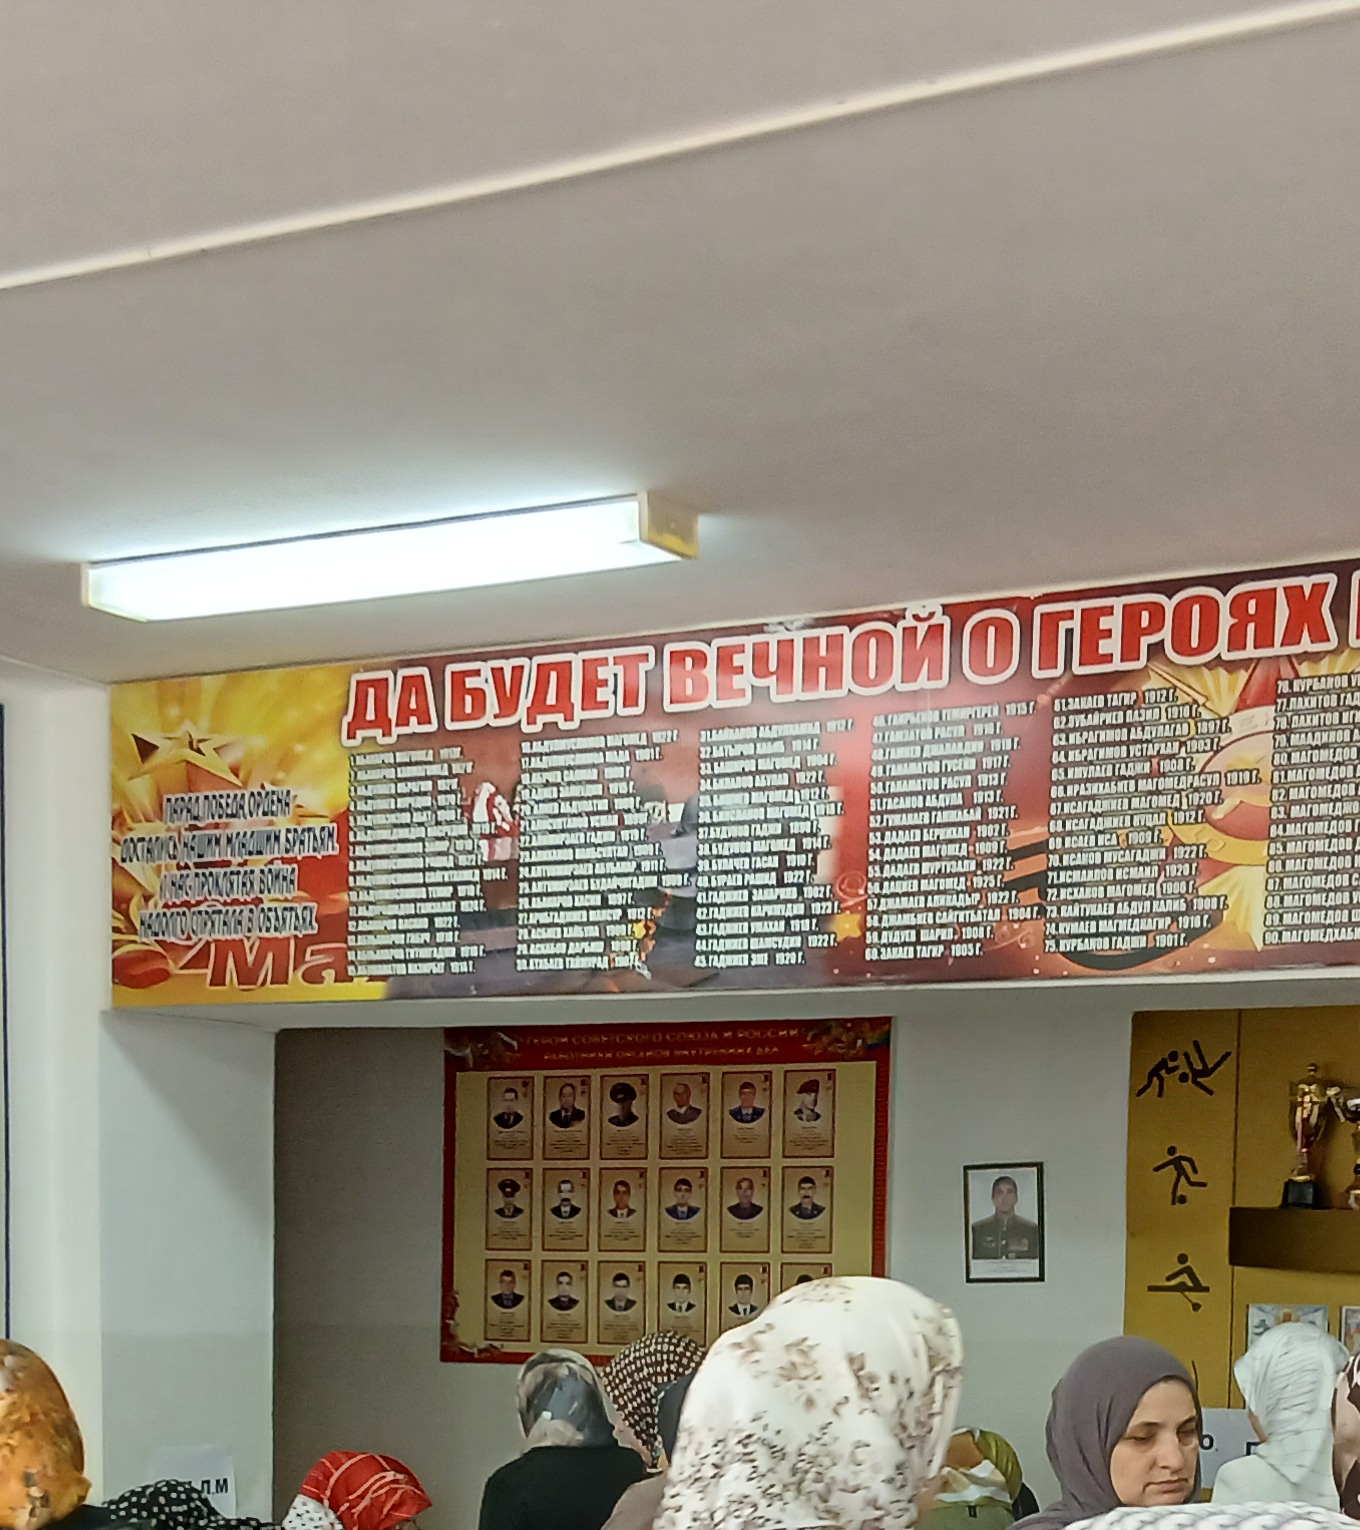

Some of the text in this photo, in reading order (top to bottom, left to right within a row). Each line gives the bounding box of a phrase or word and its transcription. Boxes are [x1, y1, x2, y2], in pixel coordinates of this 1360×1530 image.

[344, 668, 437, 742] ДА
[448, 650, 649, 724] БУДЕТ
[668, 606, 947, 707] ВЕЧНОЙ
[968, 614, 1014, 676] О
[1038, 578, 1332, 674] ГЕРОЯХ
[1290, 745, 1356, 764] МАГОМЕДОВ
[1288, 782, 1355, 801] МАГОМЕДОВ
